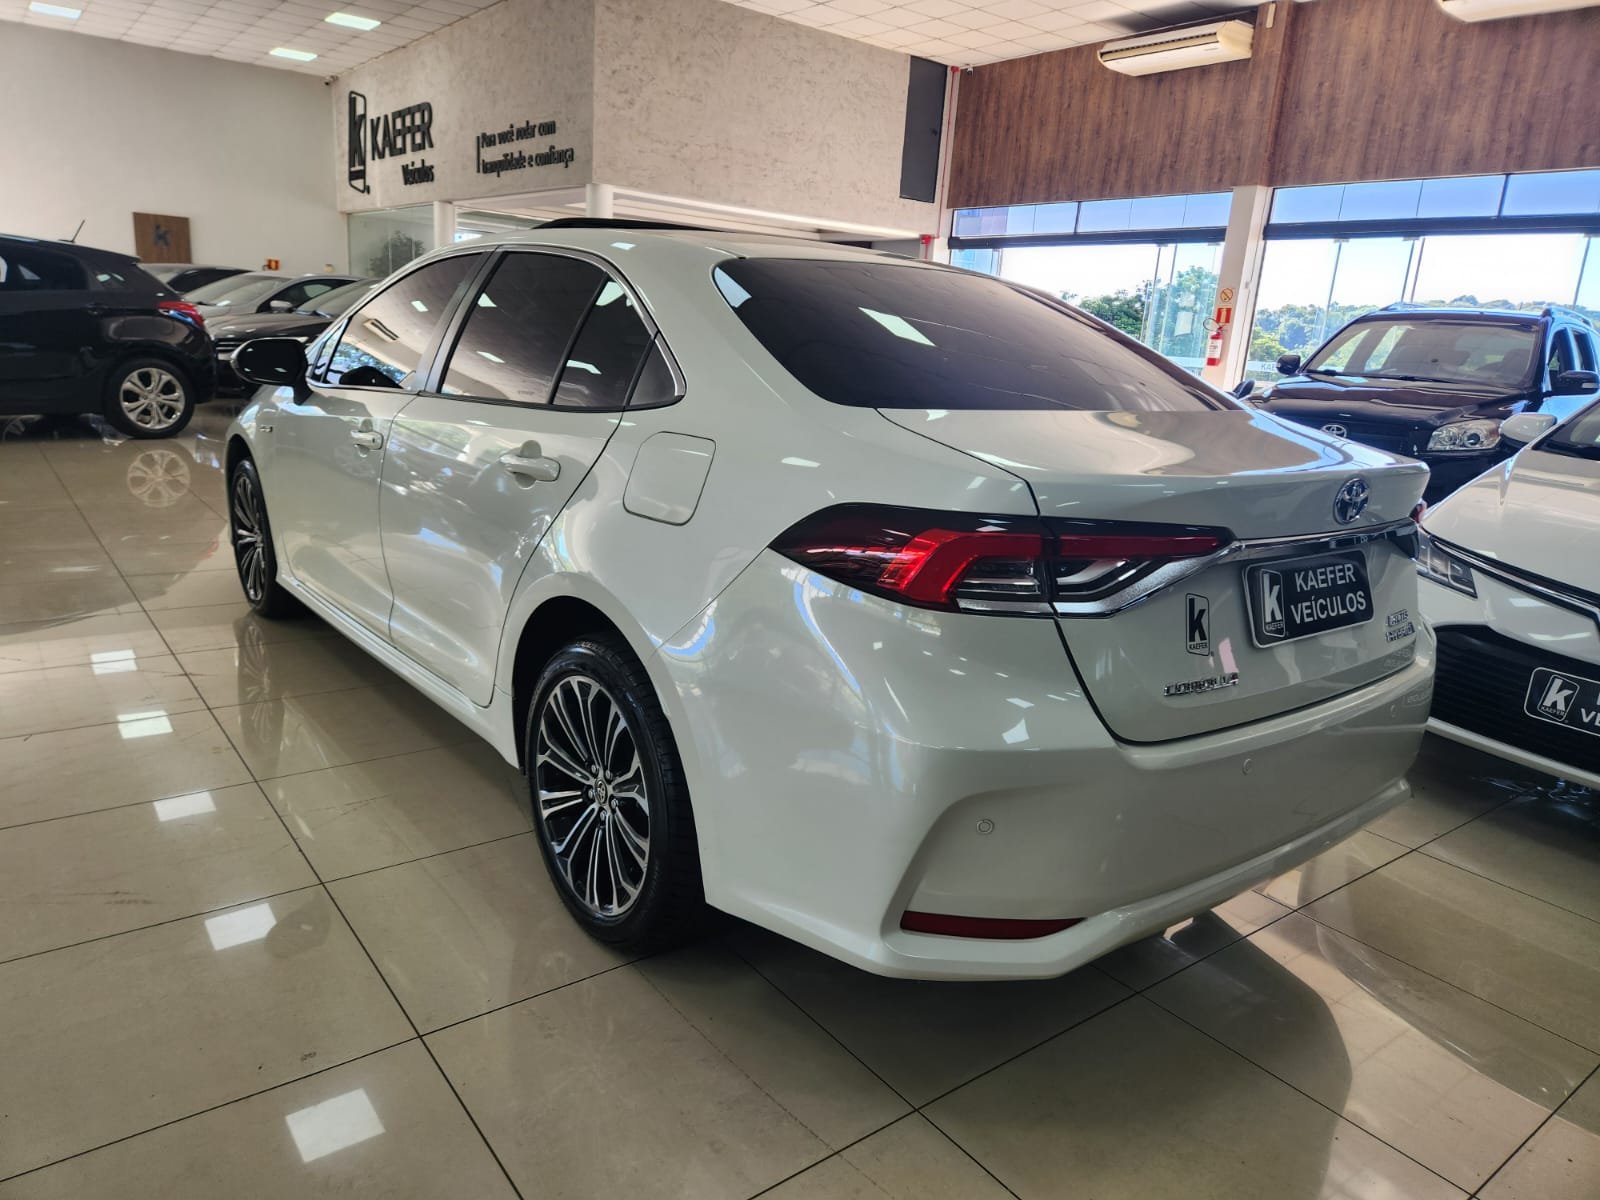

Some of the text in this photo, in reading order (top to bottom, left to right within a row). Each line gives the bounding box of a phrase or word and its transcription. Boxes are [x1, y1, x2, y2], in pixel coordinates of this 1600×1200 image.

[370, 101, 434, 161] KAEFER
[538, 120, 556, 137] com
[535, 144, 575, 169] confiança
[1295, 563, 1356, 593] KAEFER
[1290, 590, 1367, 624] VEÍCULOS
[1164, 671, 1240, 697] COROLLA
